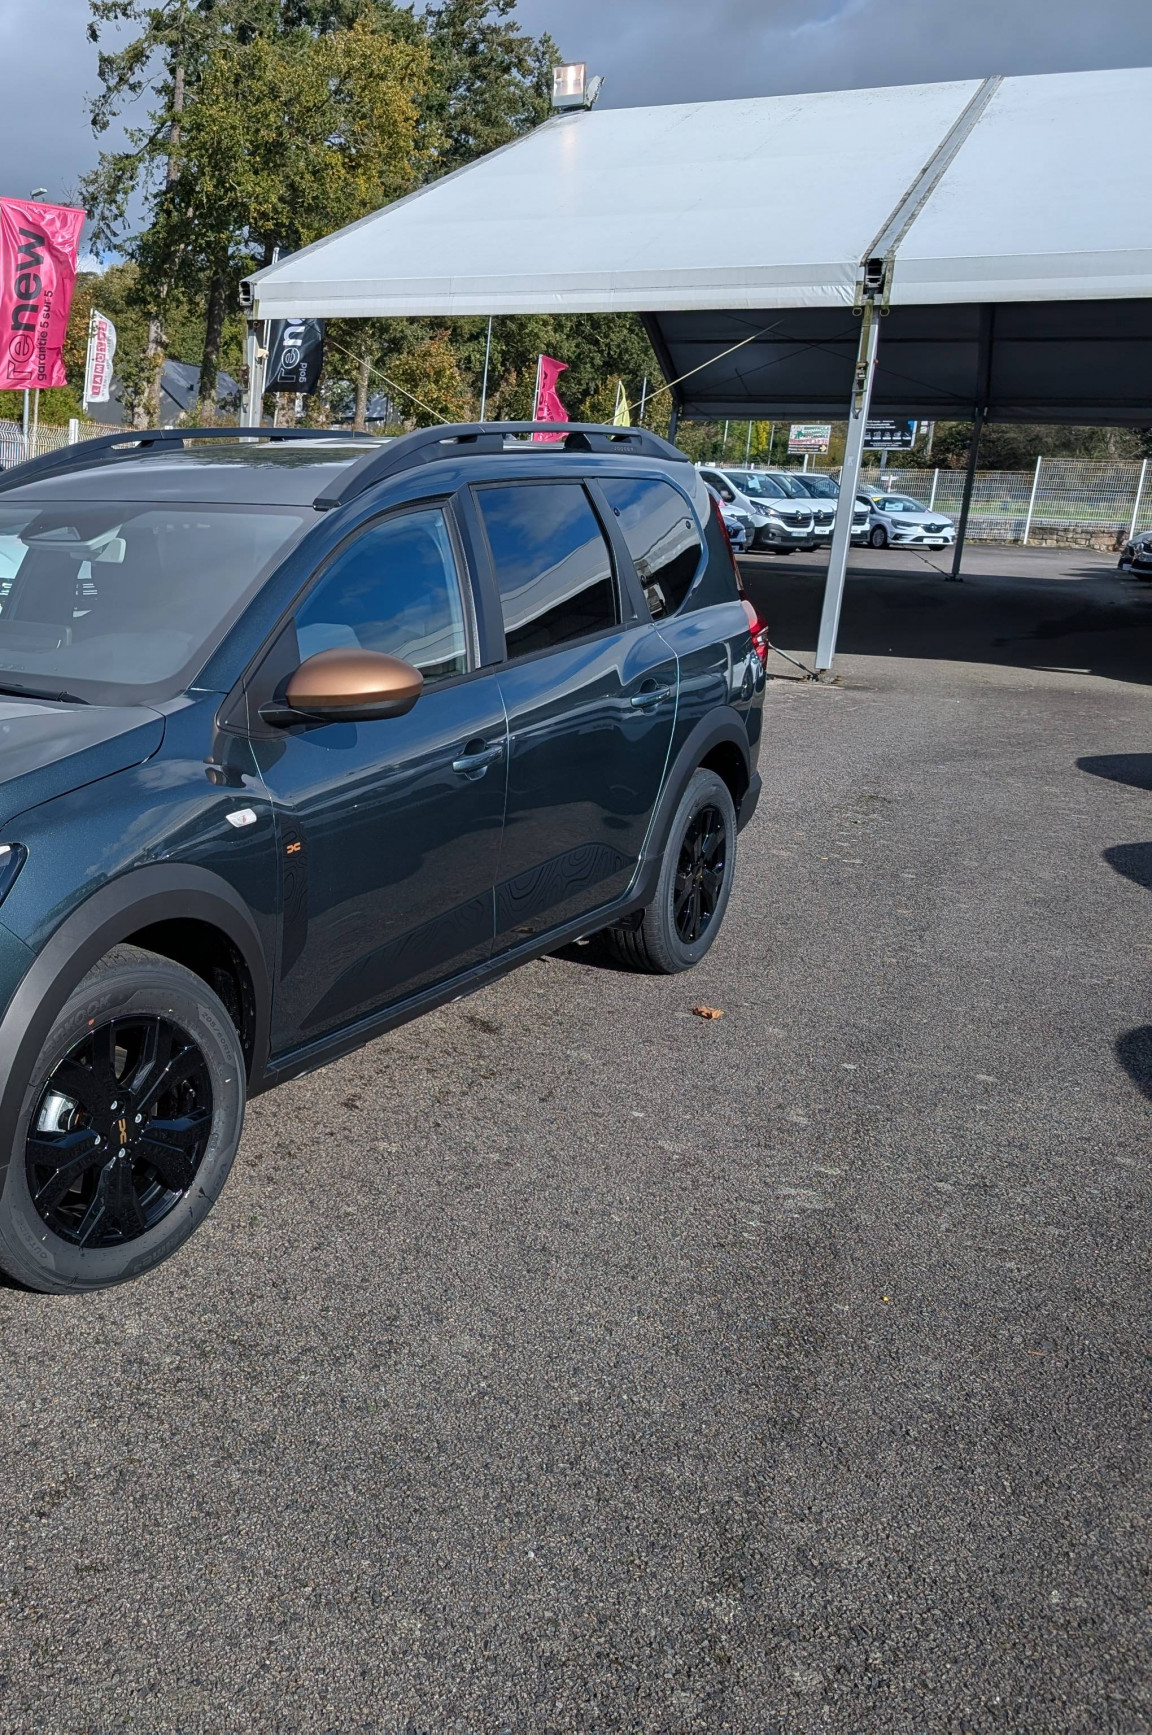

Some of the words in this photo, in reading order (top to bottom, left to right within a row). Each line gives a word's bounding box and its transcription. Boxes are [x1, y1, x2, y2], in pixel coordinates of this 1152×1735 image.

[6, 226, 46, 381] renew
[45, 290, 53, 298] 5
[44, 300, 52, 320] sur
[42, 320, 49, 329] 5
[37, 330, 48, 382] garantie
[277, 318, 306, 383] ren
[298, 362, 308, 383] gold
